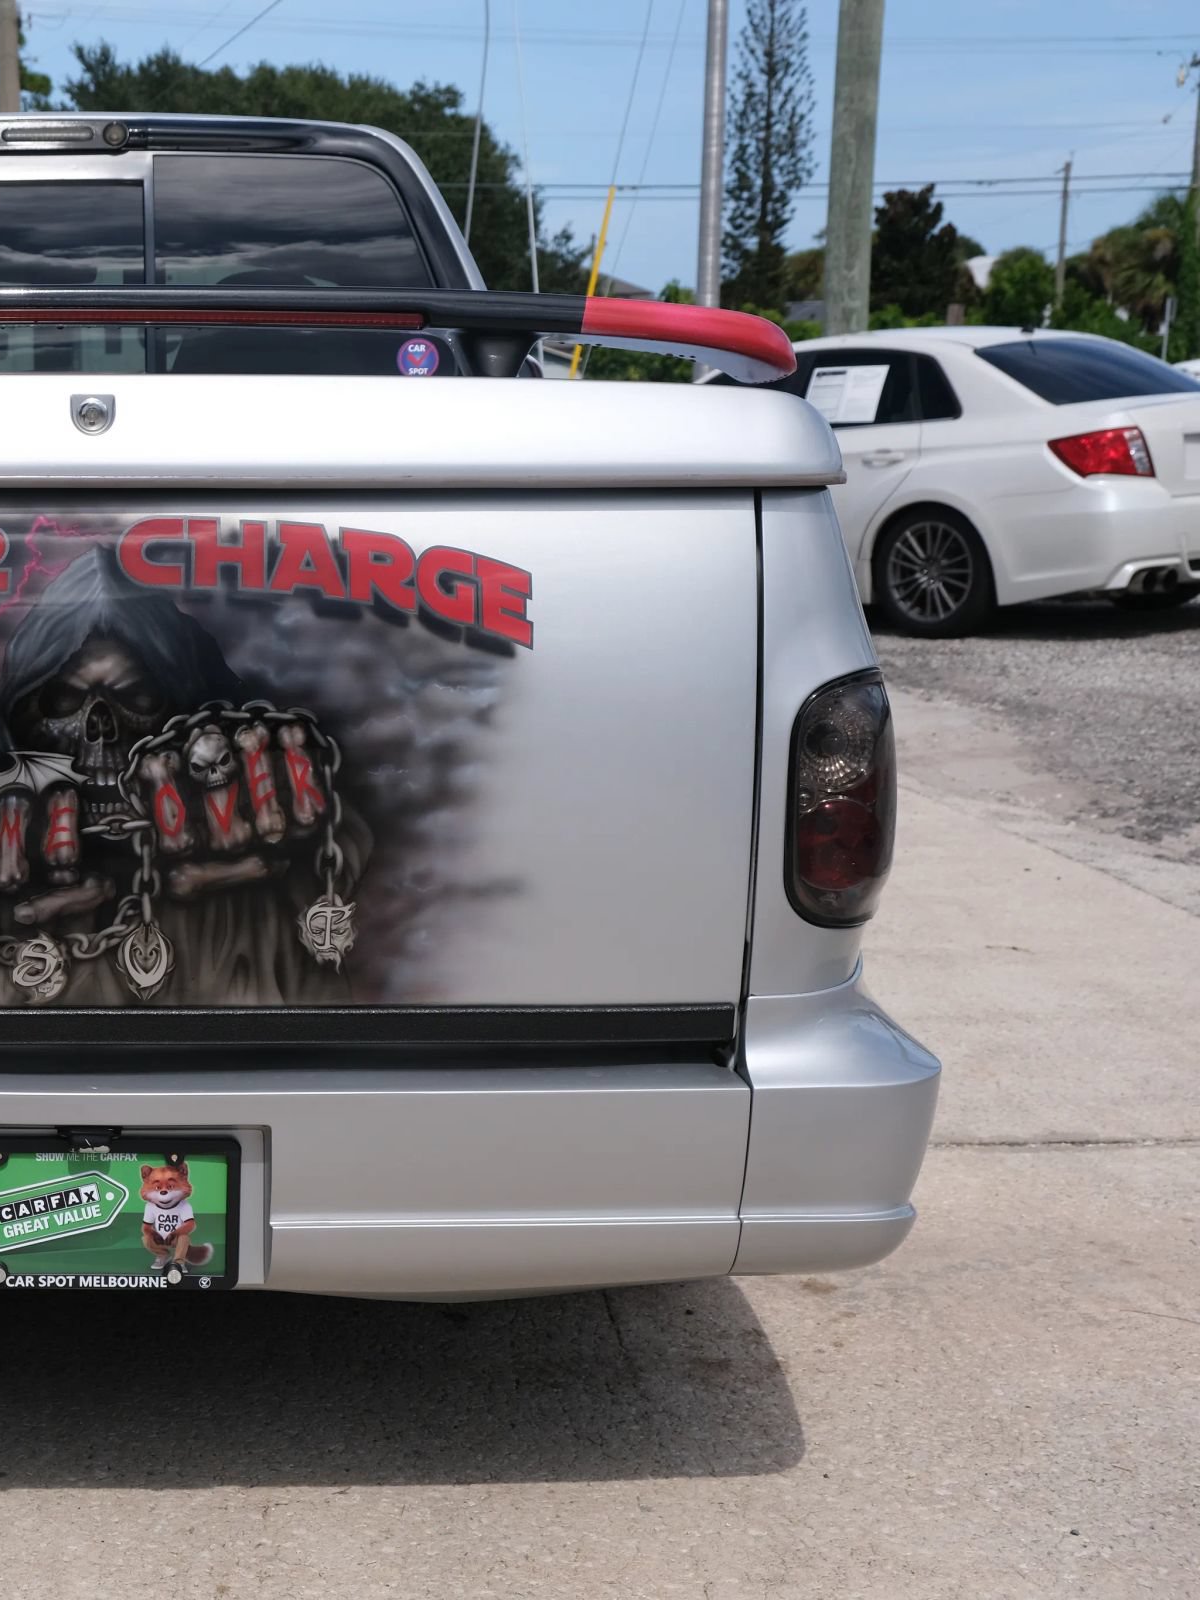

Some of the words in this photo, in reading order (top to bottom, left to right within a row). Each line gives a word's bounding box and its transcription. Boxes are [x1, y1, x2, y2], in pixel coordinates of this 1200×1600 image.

[408, 344, 426, 352] CAR
[408, 367, 428, 375] SPOT
[116, 516, 534, 650] CHARGE
[153, 737, 327, 838] OVER
[0, 1186, 98, 1222] CARFAX
[3, 1216, 51, 1238] GREAT
[54, 1204, 102, 1226] VALUE
[157, 1214, 179, 1223] CAR
[158, 1224, 178, 1232] FOX
[5, 1276, 35, 1287] CAR
[38, 1276, 75, 1287] SPOT
[79, 1276, 168, 1288] MELBOURNE
